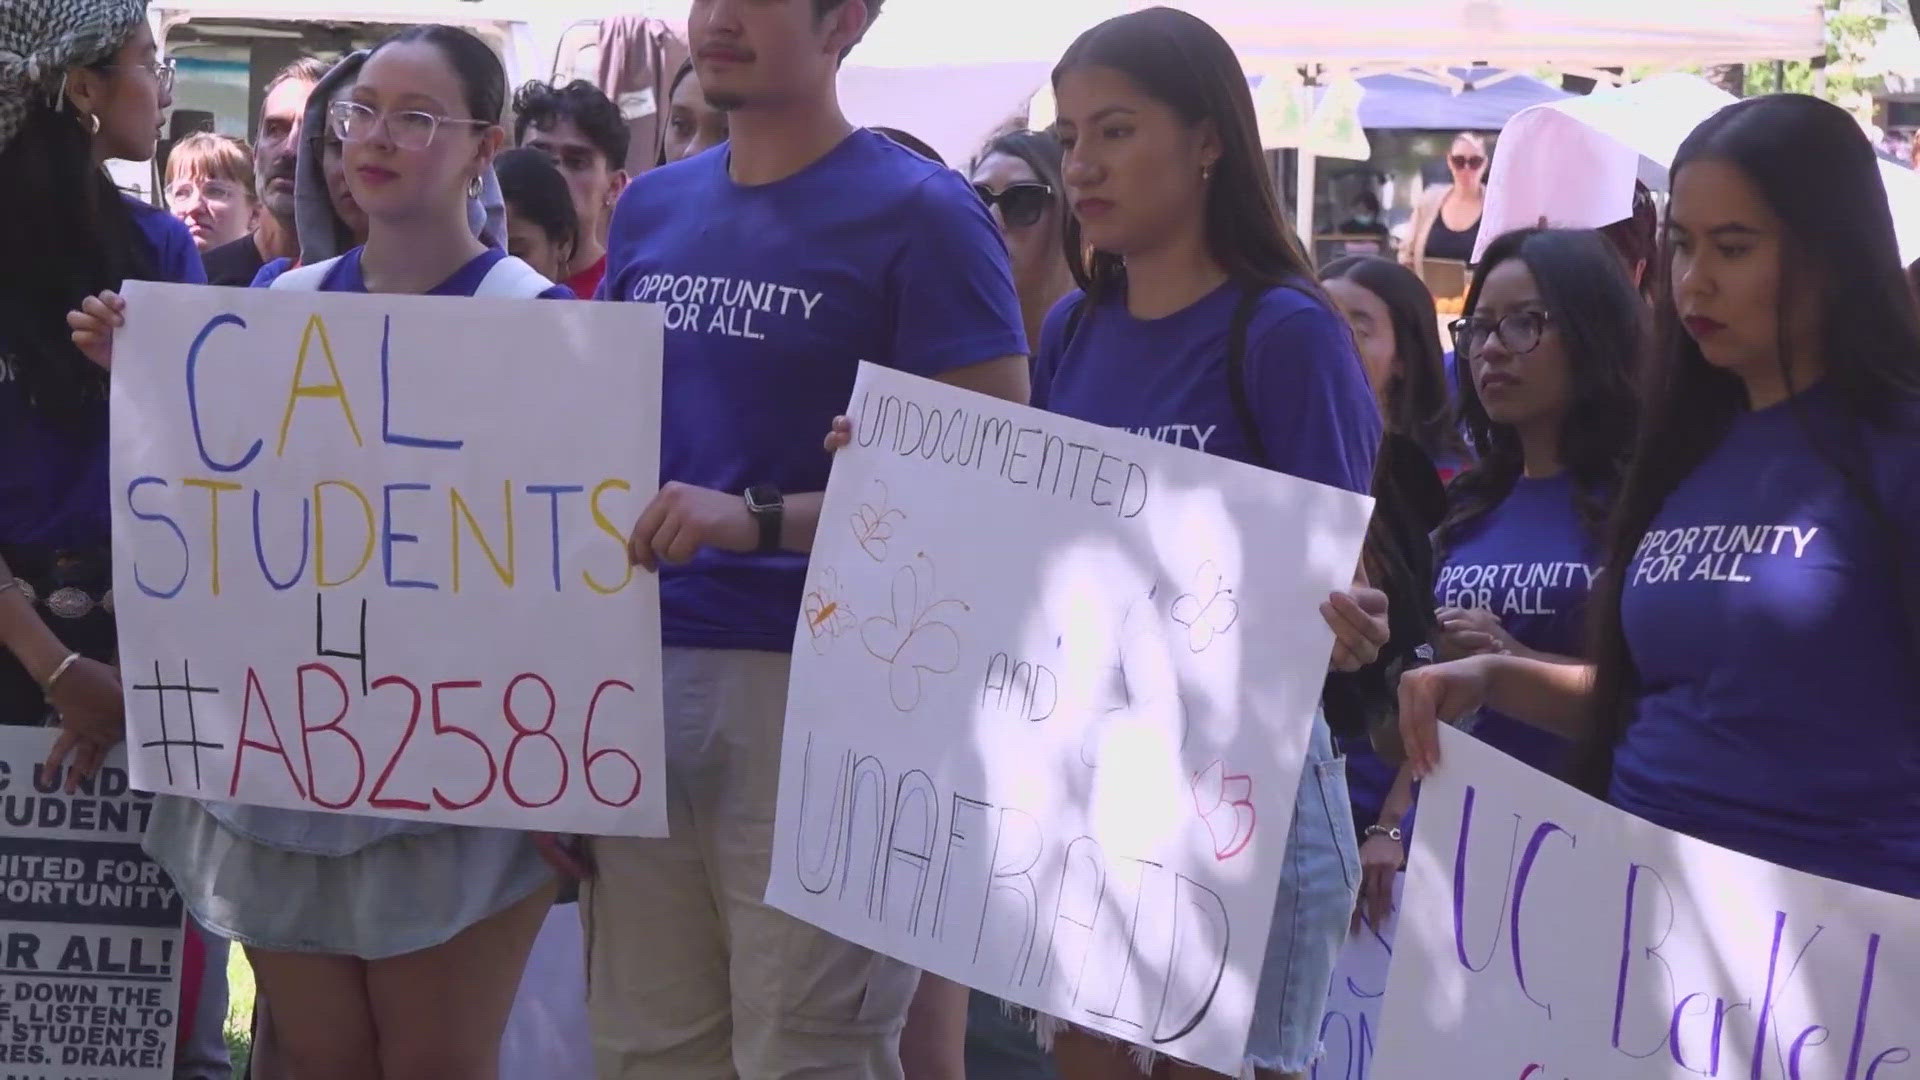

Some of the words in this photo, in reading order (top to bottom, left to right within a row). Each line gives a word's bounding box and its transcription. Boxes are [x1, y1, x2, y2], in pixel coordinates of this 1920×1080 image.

[633, 274, 823, 320] OPPORTUNITY
[655, 302, 700, 332] OR
[707, 305, 765, 340] ALL.
[186, 314, 463, 472] CAL
[858, 390, 1148, 519] UNDOCUMENTED
[128, 476, 635, 599] STUDENTS
[1633, 525, 1818, 560] PPORTUNITY
[1434, 562, 1605, 595] PPORTUNITY
[1633, 554, 1687, 587] FOR
[1688, 553, 1752, 582] ALL.
[1502, 587, 1556, 615] ALL.
[317, 593, 368, 697] 4
[982, 651, 1058, 722] AND
[133, 659, 642, 811] #AB2586
[33, 762, 155, 799] UND
[0, 795, 152, 833] UDENT
[96, 859, 160, 885] FOR
[796, 730, 1230, 1044] UNAFRAID
[0, 879, 175, 910] ORTUNITY
[1454, 785, 1577, 1020] UC
[56, 935, 174, 976] ALL!
[15, 982, 98, 1004] DOWN
[108, 986, 162, 1007] THE
[29, 1003, 127, 1026] LISTEN
[137, 1008, 173, 1028] TO
[12, 1022, 166, 1050] STUDENTS,
[62, 1045, 166, 1069] DRAKE!
